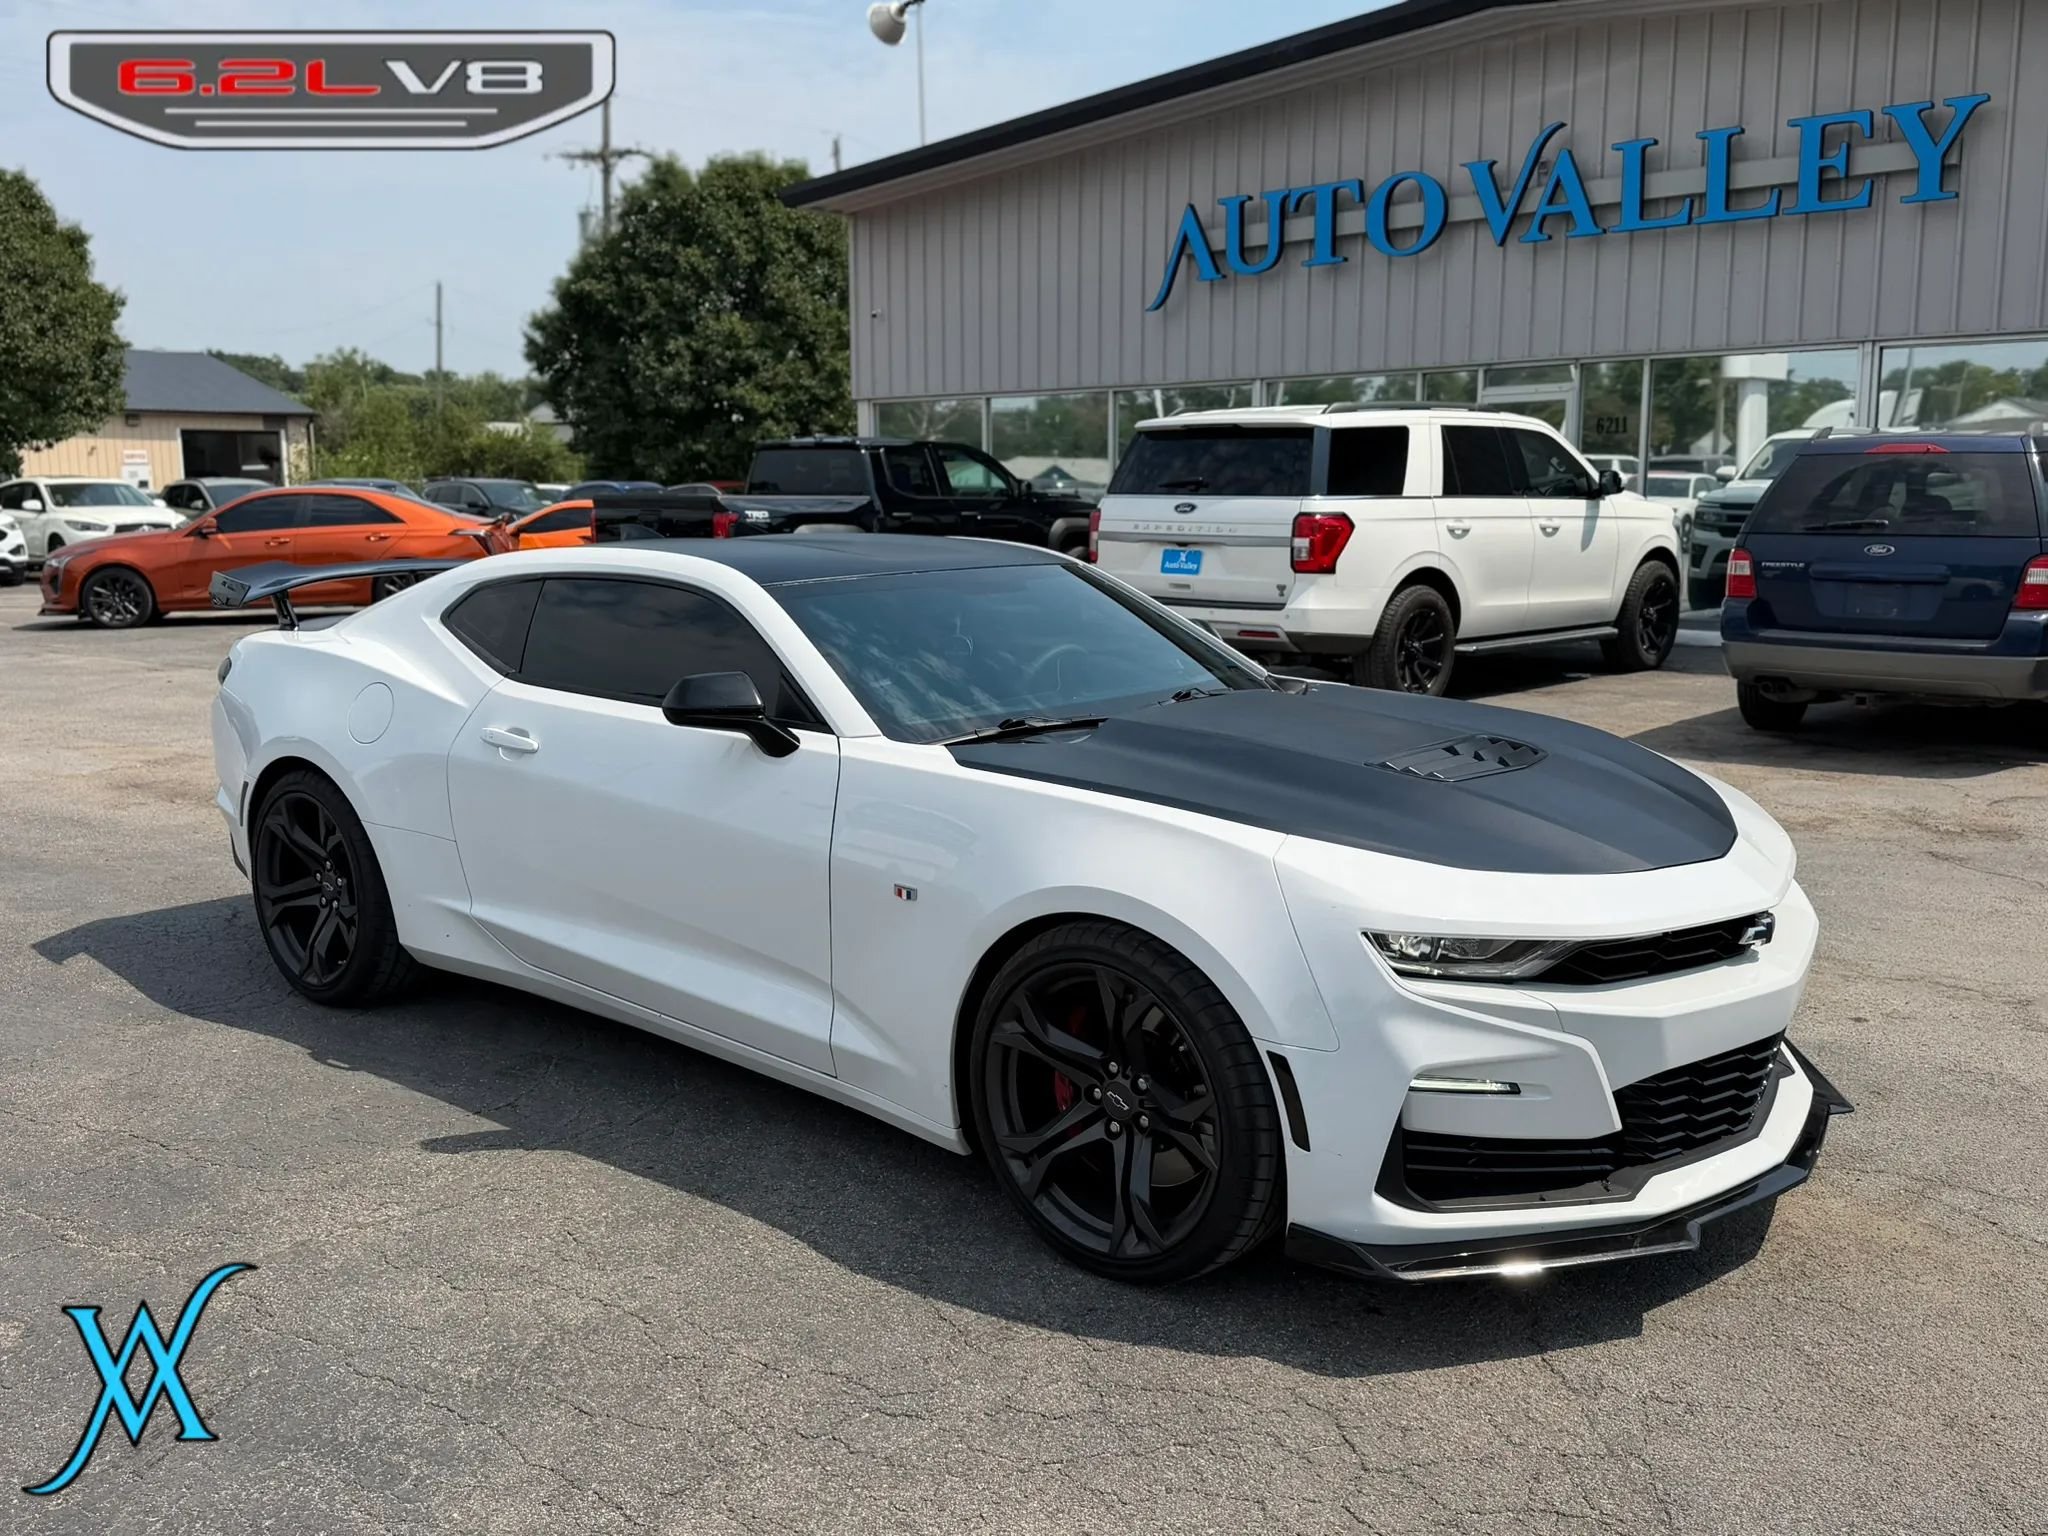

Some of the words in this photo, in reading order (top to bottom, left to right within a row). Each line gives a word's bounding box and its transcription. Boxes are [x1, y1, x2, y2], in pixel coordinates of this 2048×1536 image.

[1146, 170, 1448, 312] AUTO
[1461, 92, 1990, 247] VALLEY
[1596, 416, 1627, 435] 6211
